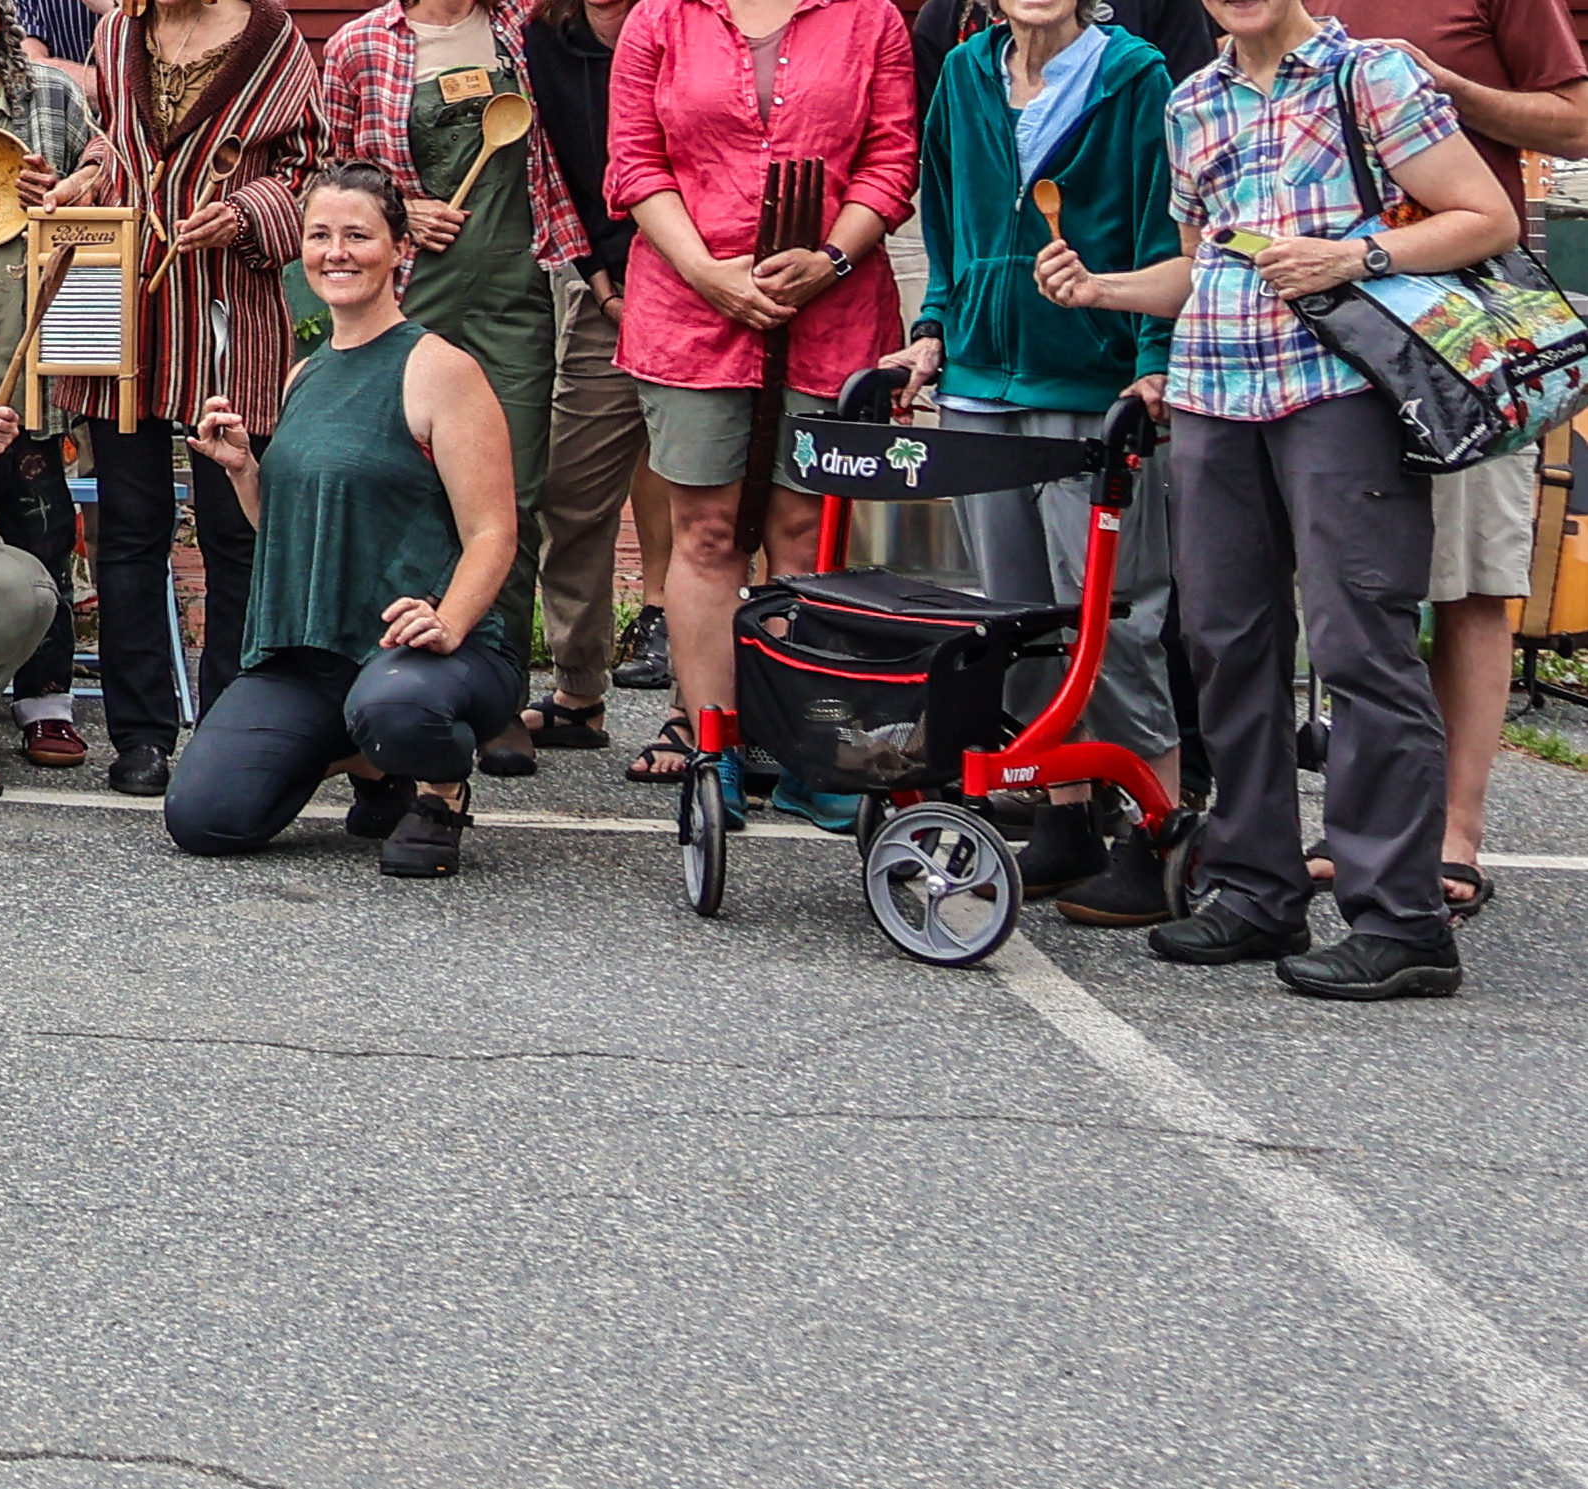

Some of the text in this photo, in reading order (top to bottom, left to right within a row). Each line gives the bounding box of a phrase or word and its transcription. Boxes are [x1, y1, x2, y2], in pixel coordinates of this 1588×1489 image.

[51, 224, 115, 243] Behrens
[821, 447, 878, 476] drive
[1001, 765, 1036, 783] NITRO
